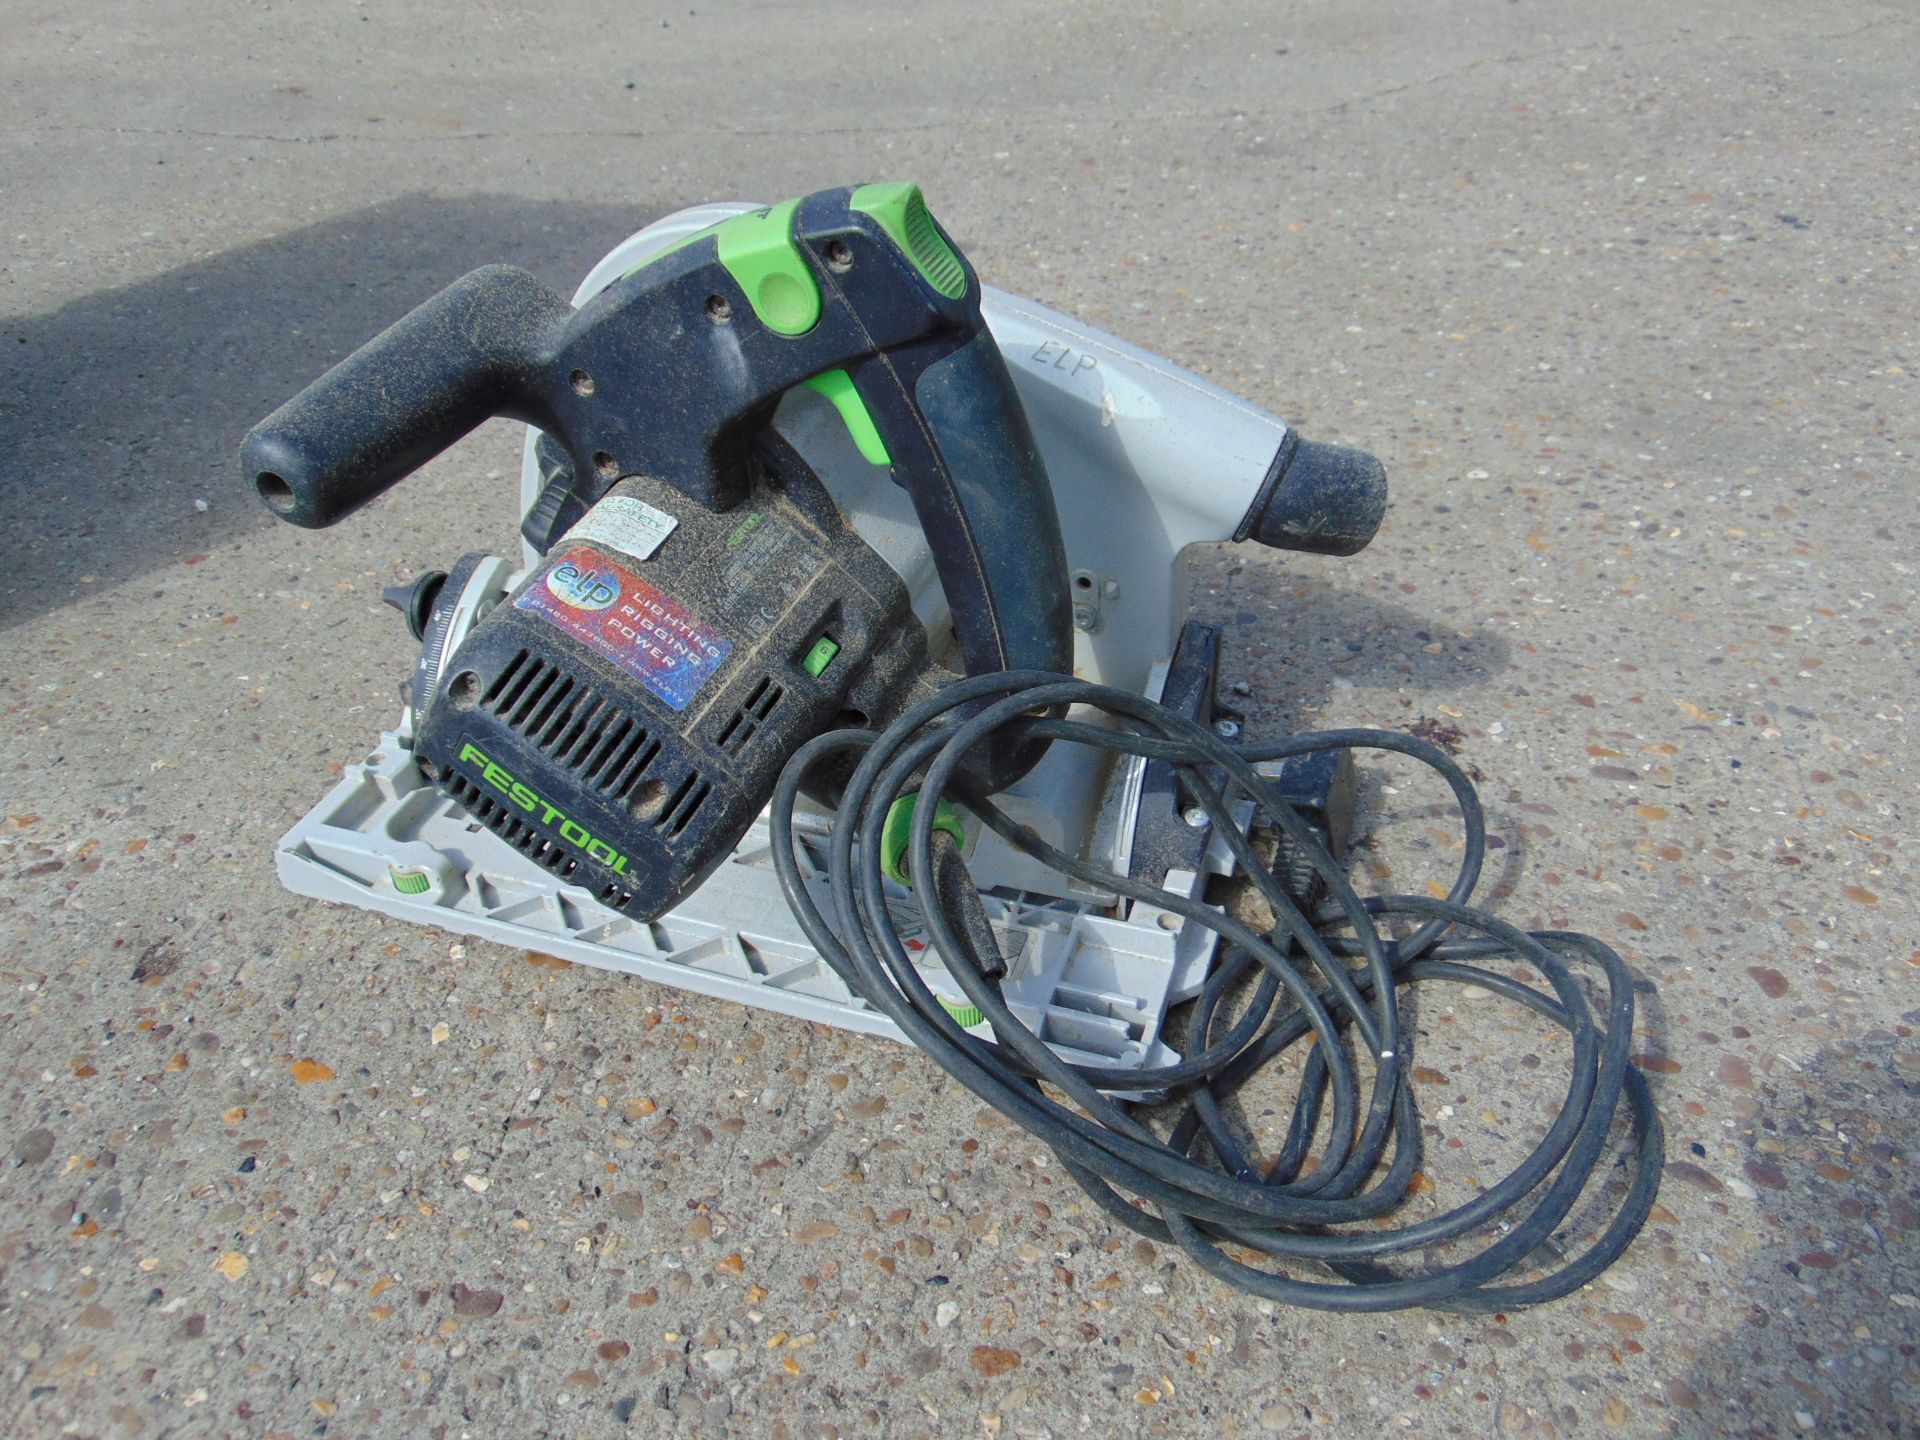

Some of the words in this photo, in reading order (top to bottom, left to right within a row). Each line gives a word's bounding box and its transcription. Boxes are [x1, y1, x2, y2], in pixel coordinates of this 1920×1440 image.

[1030, 339, 1099, 377] ELP
[615, 504, 664, 528] SAFETY
[552, 564, 615, 606] elp
[607, 618, 678, 669] POWER
[620, 605, 704, 666] RIGGING
[632, 592, 721, 658] LIGHTING
[459, 742, 634, 878] FESTOOL
